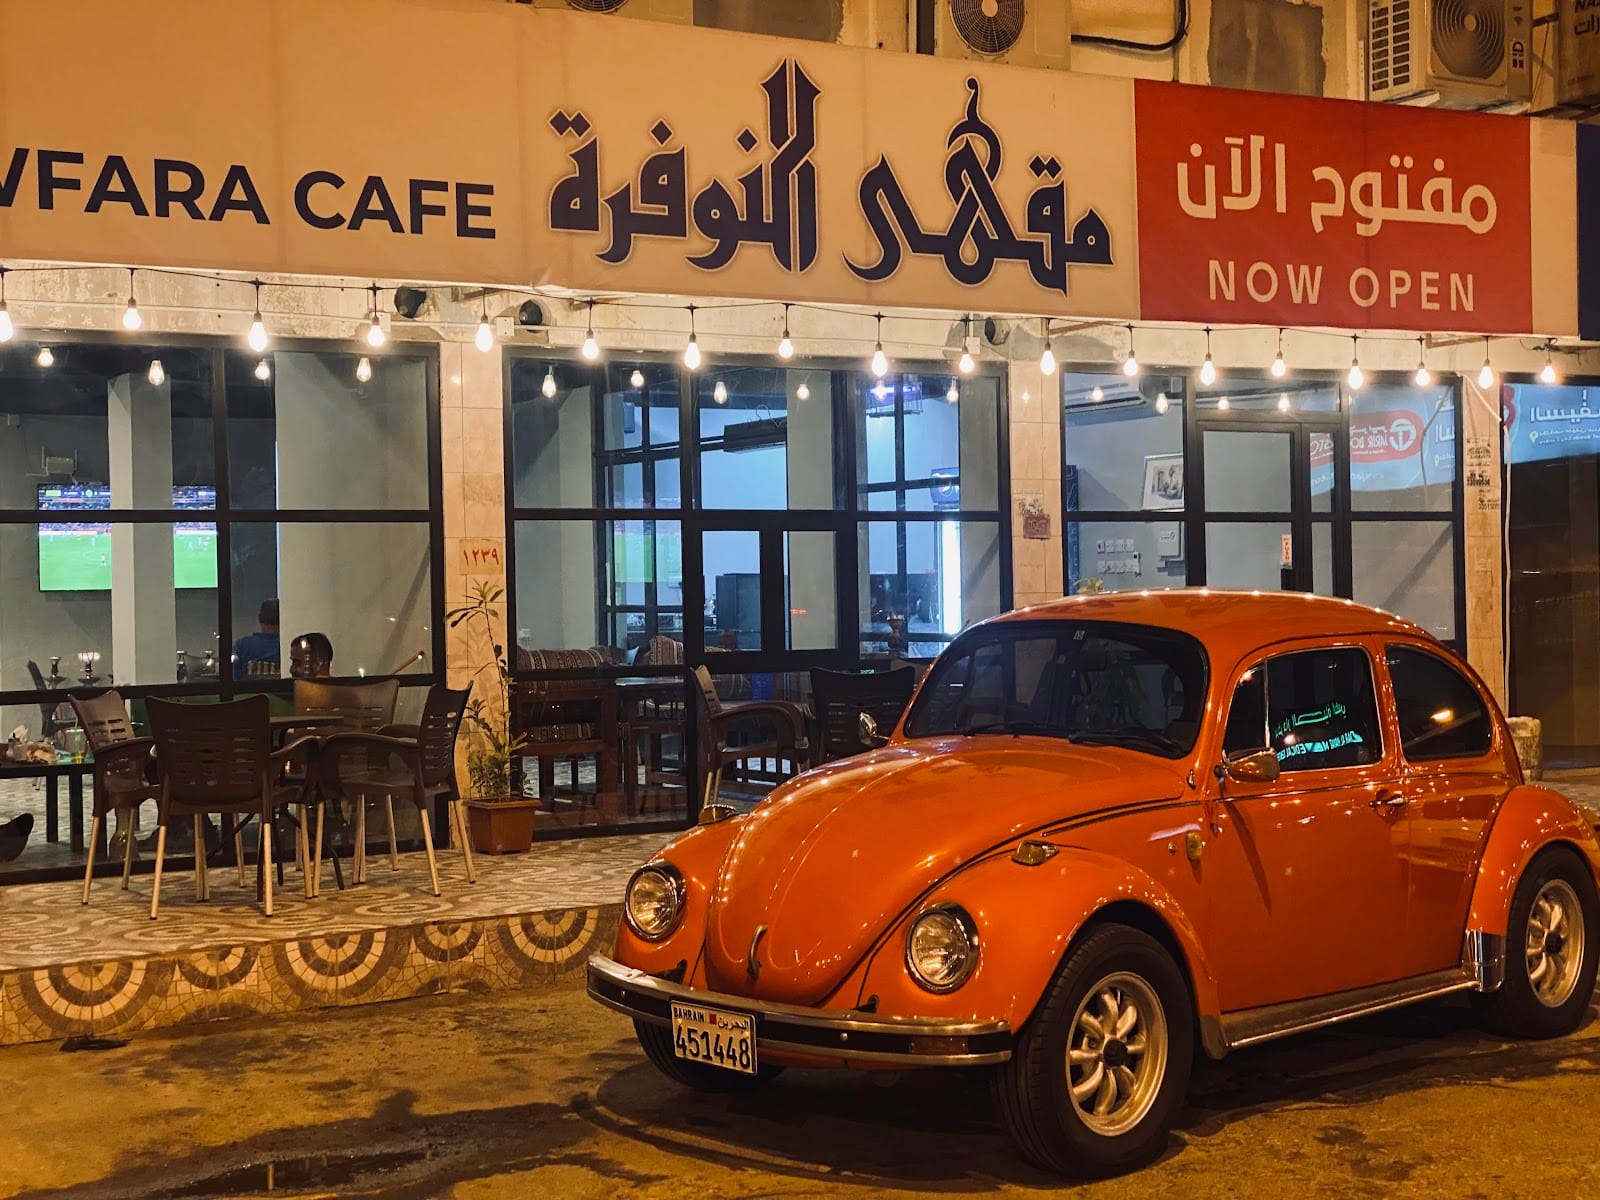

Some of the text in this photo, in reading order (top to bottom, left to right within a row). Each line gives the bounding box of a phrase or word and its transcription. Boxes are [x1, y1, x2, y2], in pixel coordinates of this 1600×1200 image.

[549, 57, 1114, 298] مقهى النوفرة
[1177, 134, 1497, 236] مفتوح الآن
[294, 170, 496, 240] CAFE
[1209, 259, 1475, 311] NOW OPEN
[463, 548, 499, 567] ١٢٣٩
[673, 1007, 705, 1022] BAHRAIN
[718, 1017, 749, 1033] البحرين
[675, 1024, 751, 1069] 451448
